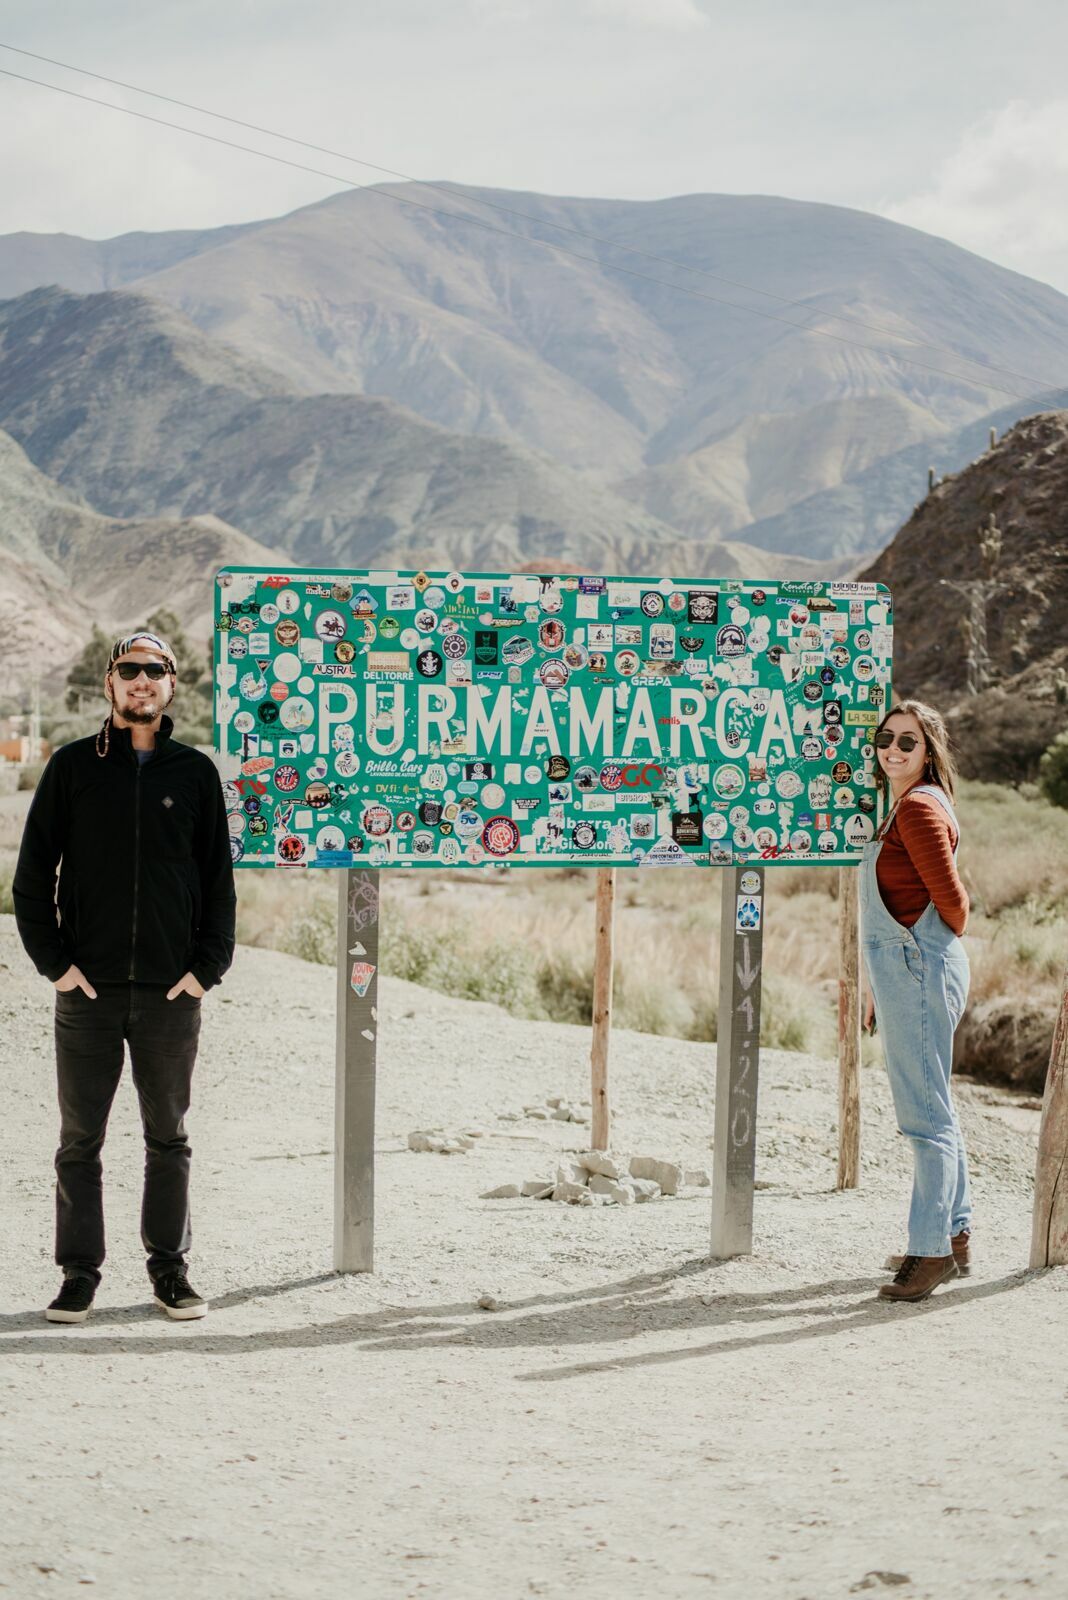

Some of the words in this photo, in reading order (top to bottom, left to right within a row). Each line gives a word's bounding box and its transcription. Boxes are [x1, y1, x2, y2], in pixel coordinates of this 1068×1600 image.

[781, 580, 813, 592] Renata
[630, 676, 672, 686] GREPA
[753, 703, 766, 712] 40
[319, 683, 797, 759] PURMAMARCA
[365, 760, 398, 774] Brillo
[400, 761, 423, 774] Cars
[667, 845, 679, 853] 40
